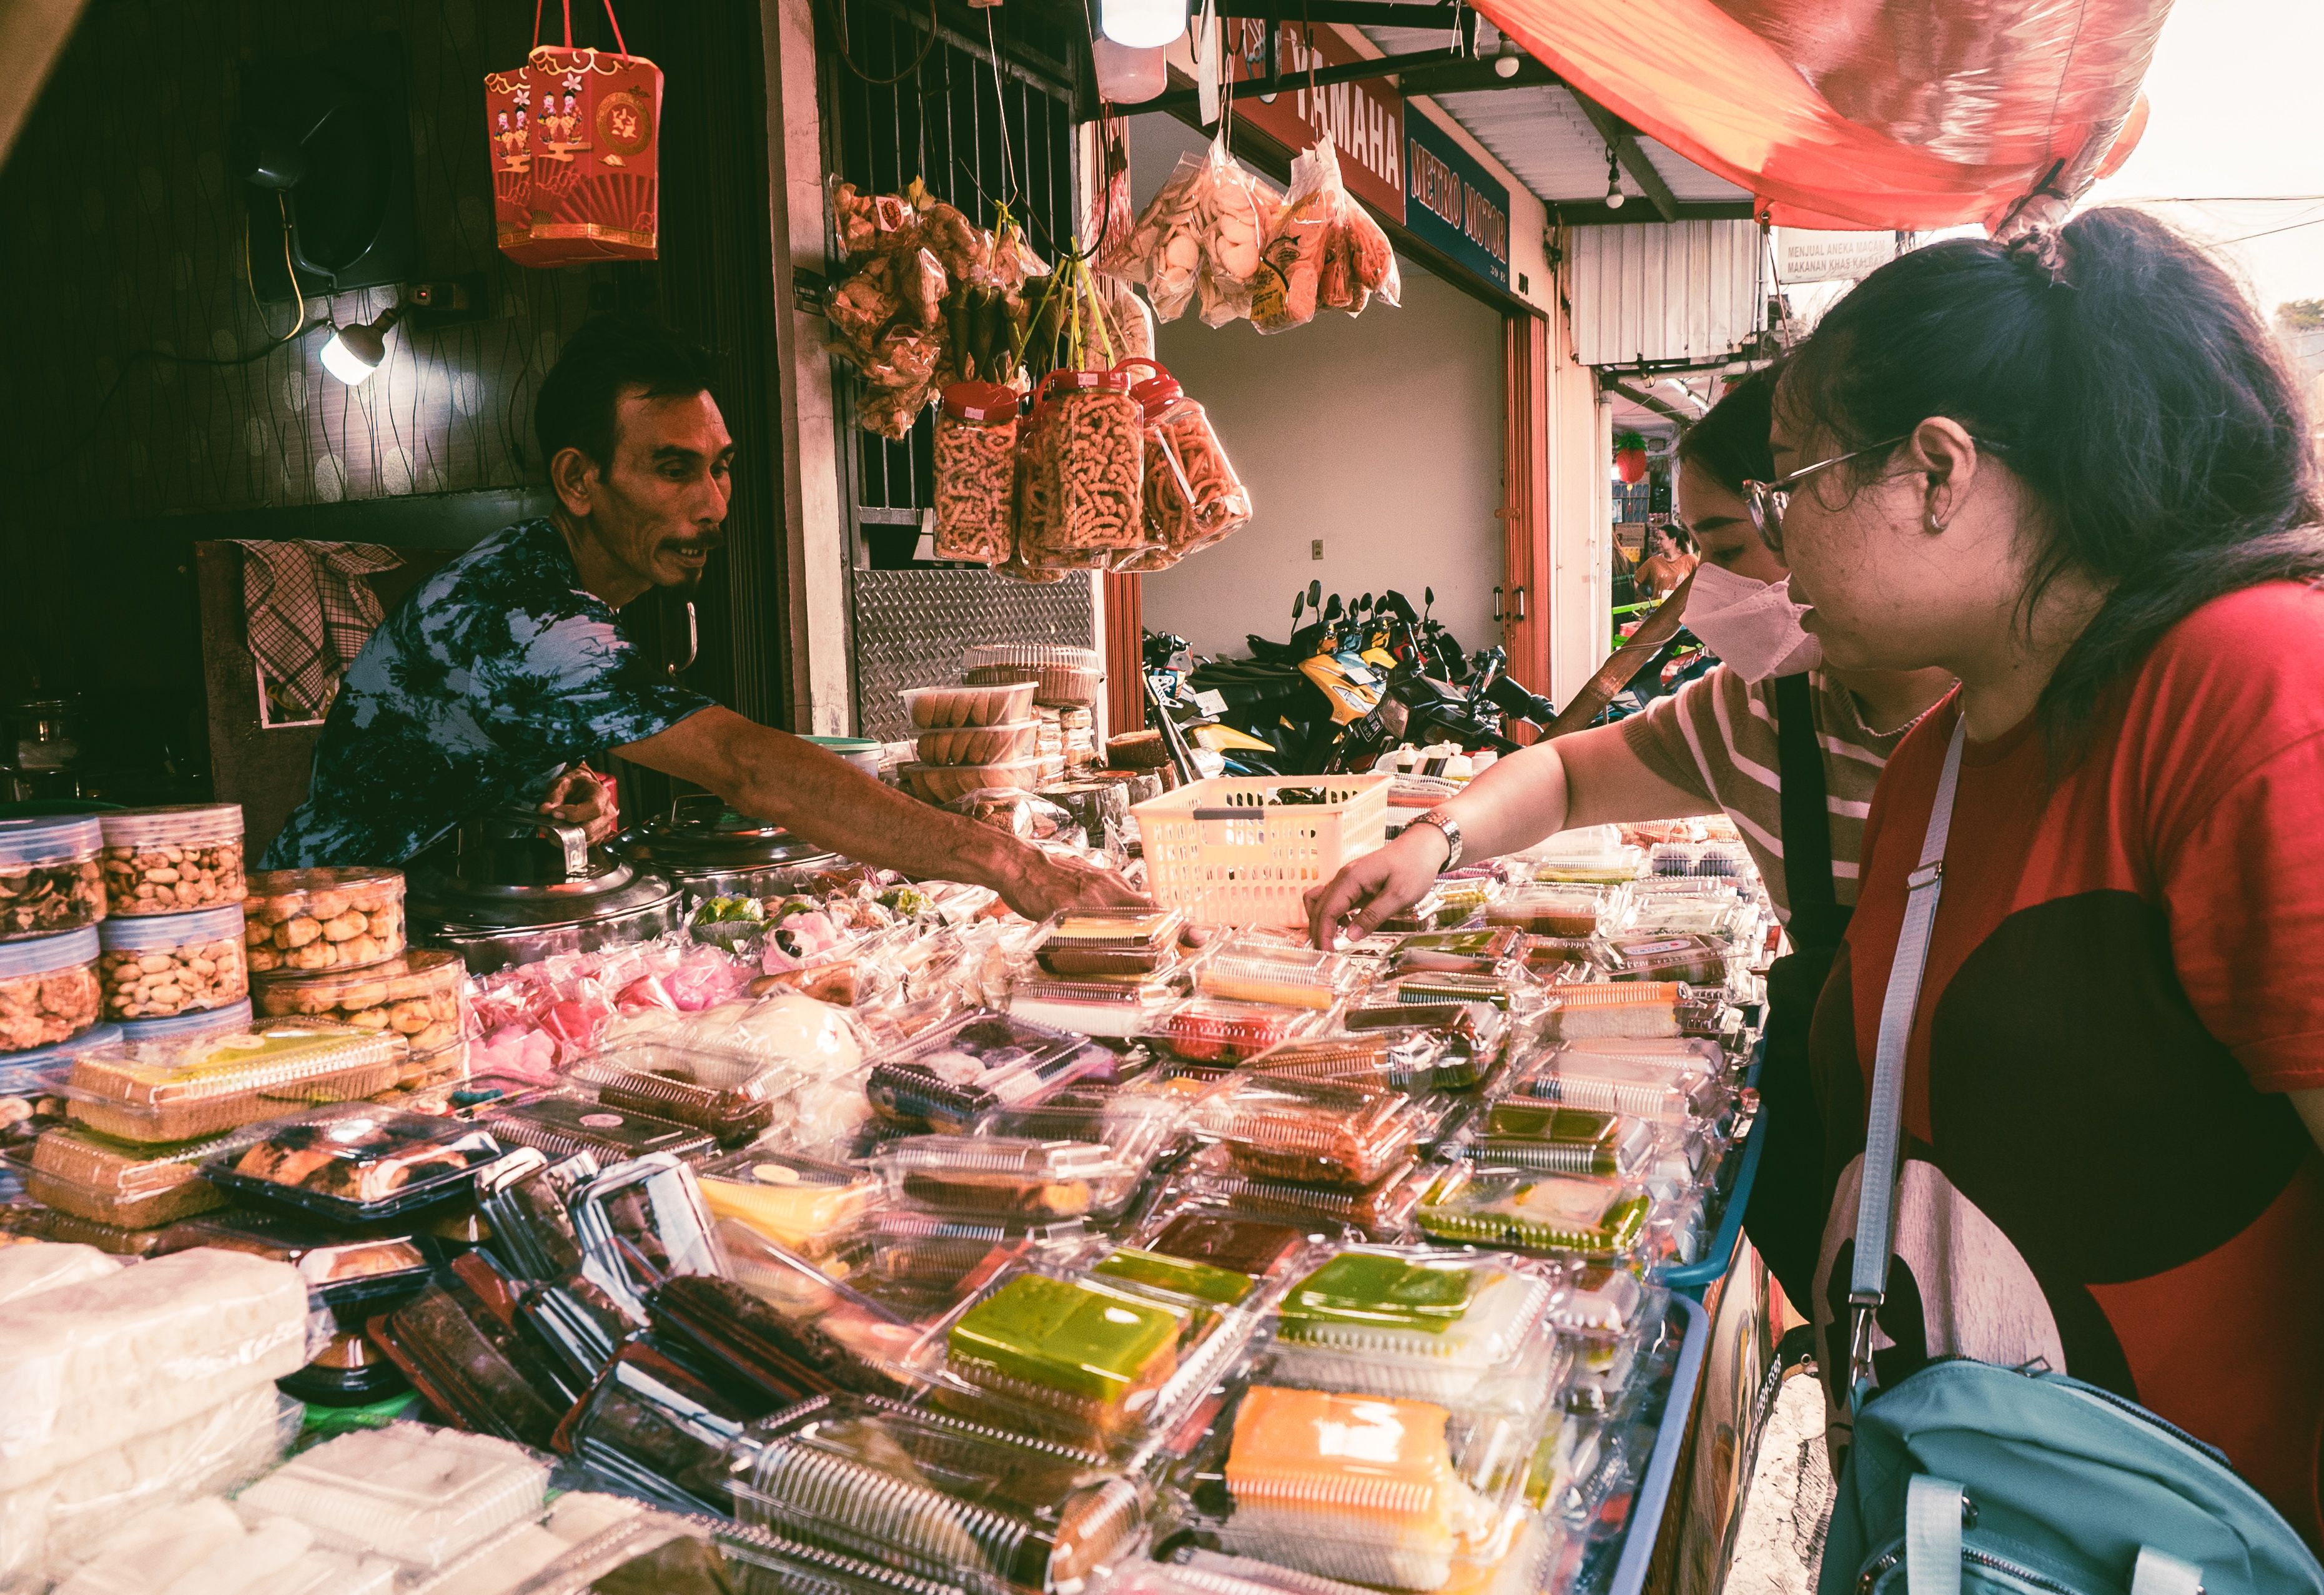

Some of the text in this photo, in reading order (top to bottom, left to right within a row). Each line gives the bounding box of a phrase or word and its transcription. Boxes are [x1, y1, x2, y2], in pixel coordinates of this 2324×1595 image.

[1289, 27, 1400, 191] YAMAHA
[1410, 137, 1506, 265] METRO MOTOR
[1788, 244, 1824, 258] MENJUAL
[1827, 243, 1854, 255] ANEKA
[1490, 264, 1498, 278] 39
[1788, 260, 1826, 273] MAKANAN
[1829, 257, 1851, 270] KHAS
